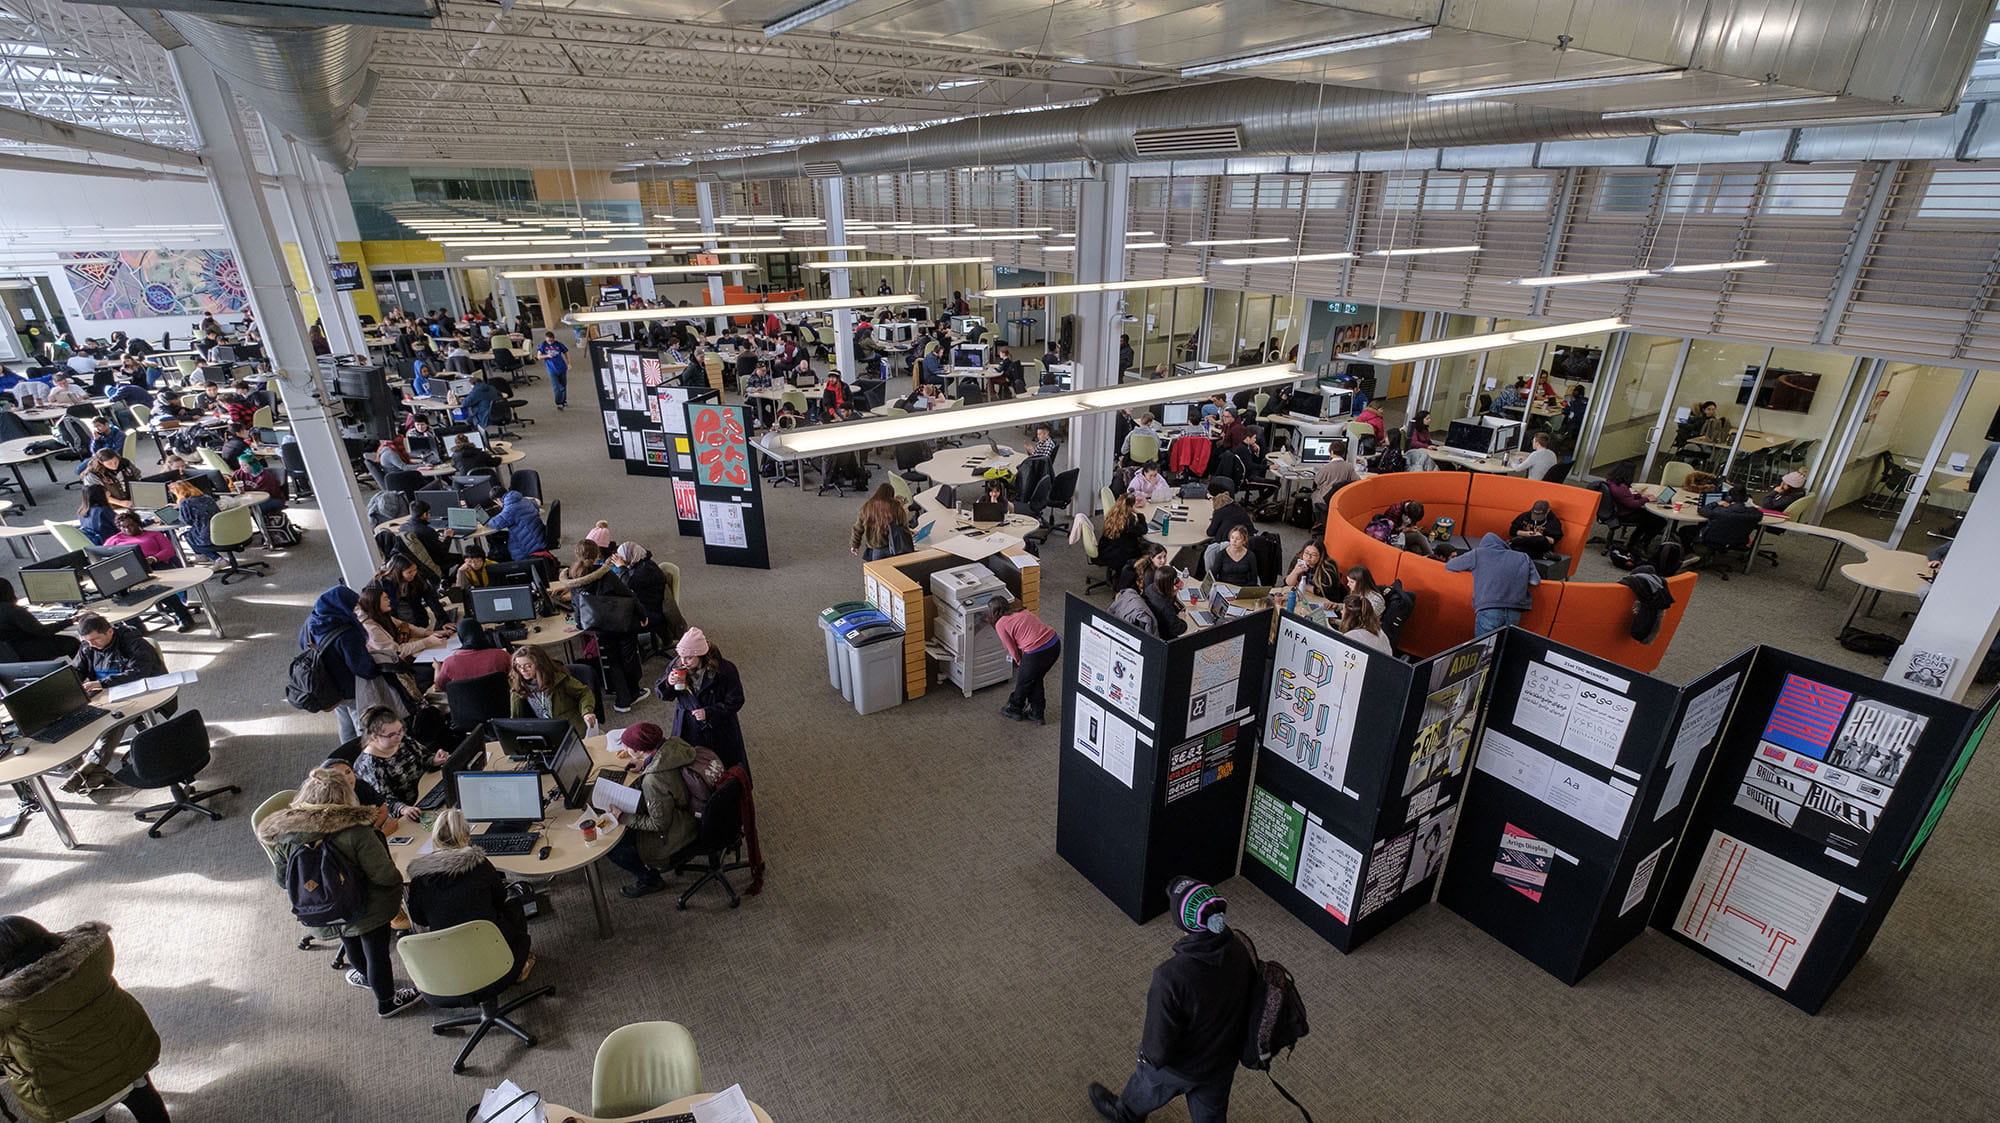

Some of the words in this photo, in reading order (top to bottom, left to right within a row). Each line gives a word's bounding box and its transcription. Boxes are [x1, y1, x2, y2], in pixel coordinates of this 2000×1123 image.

[1284, 628, 1308, 646] MFA
[1344, 650, 1356, 661] 20
[1563, 777, 1580, 790] Aa
